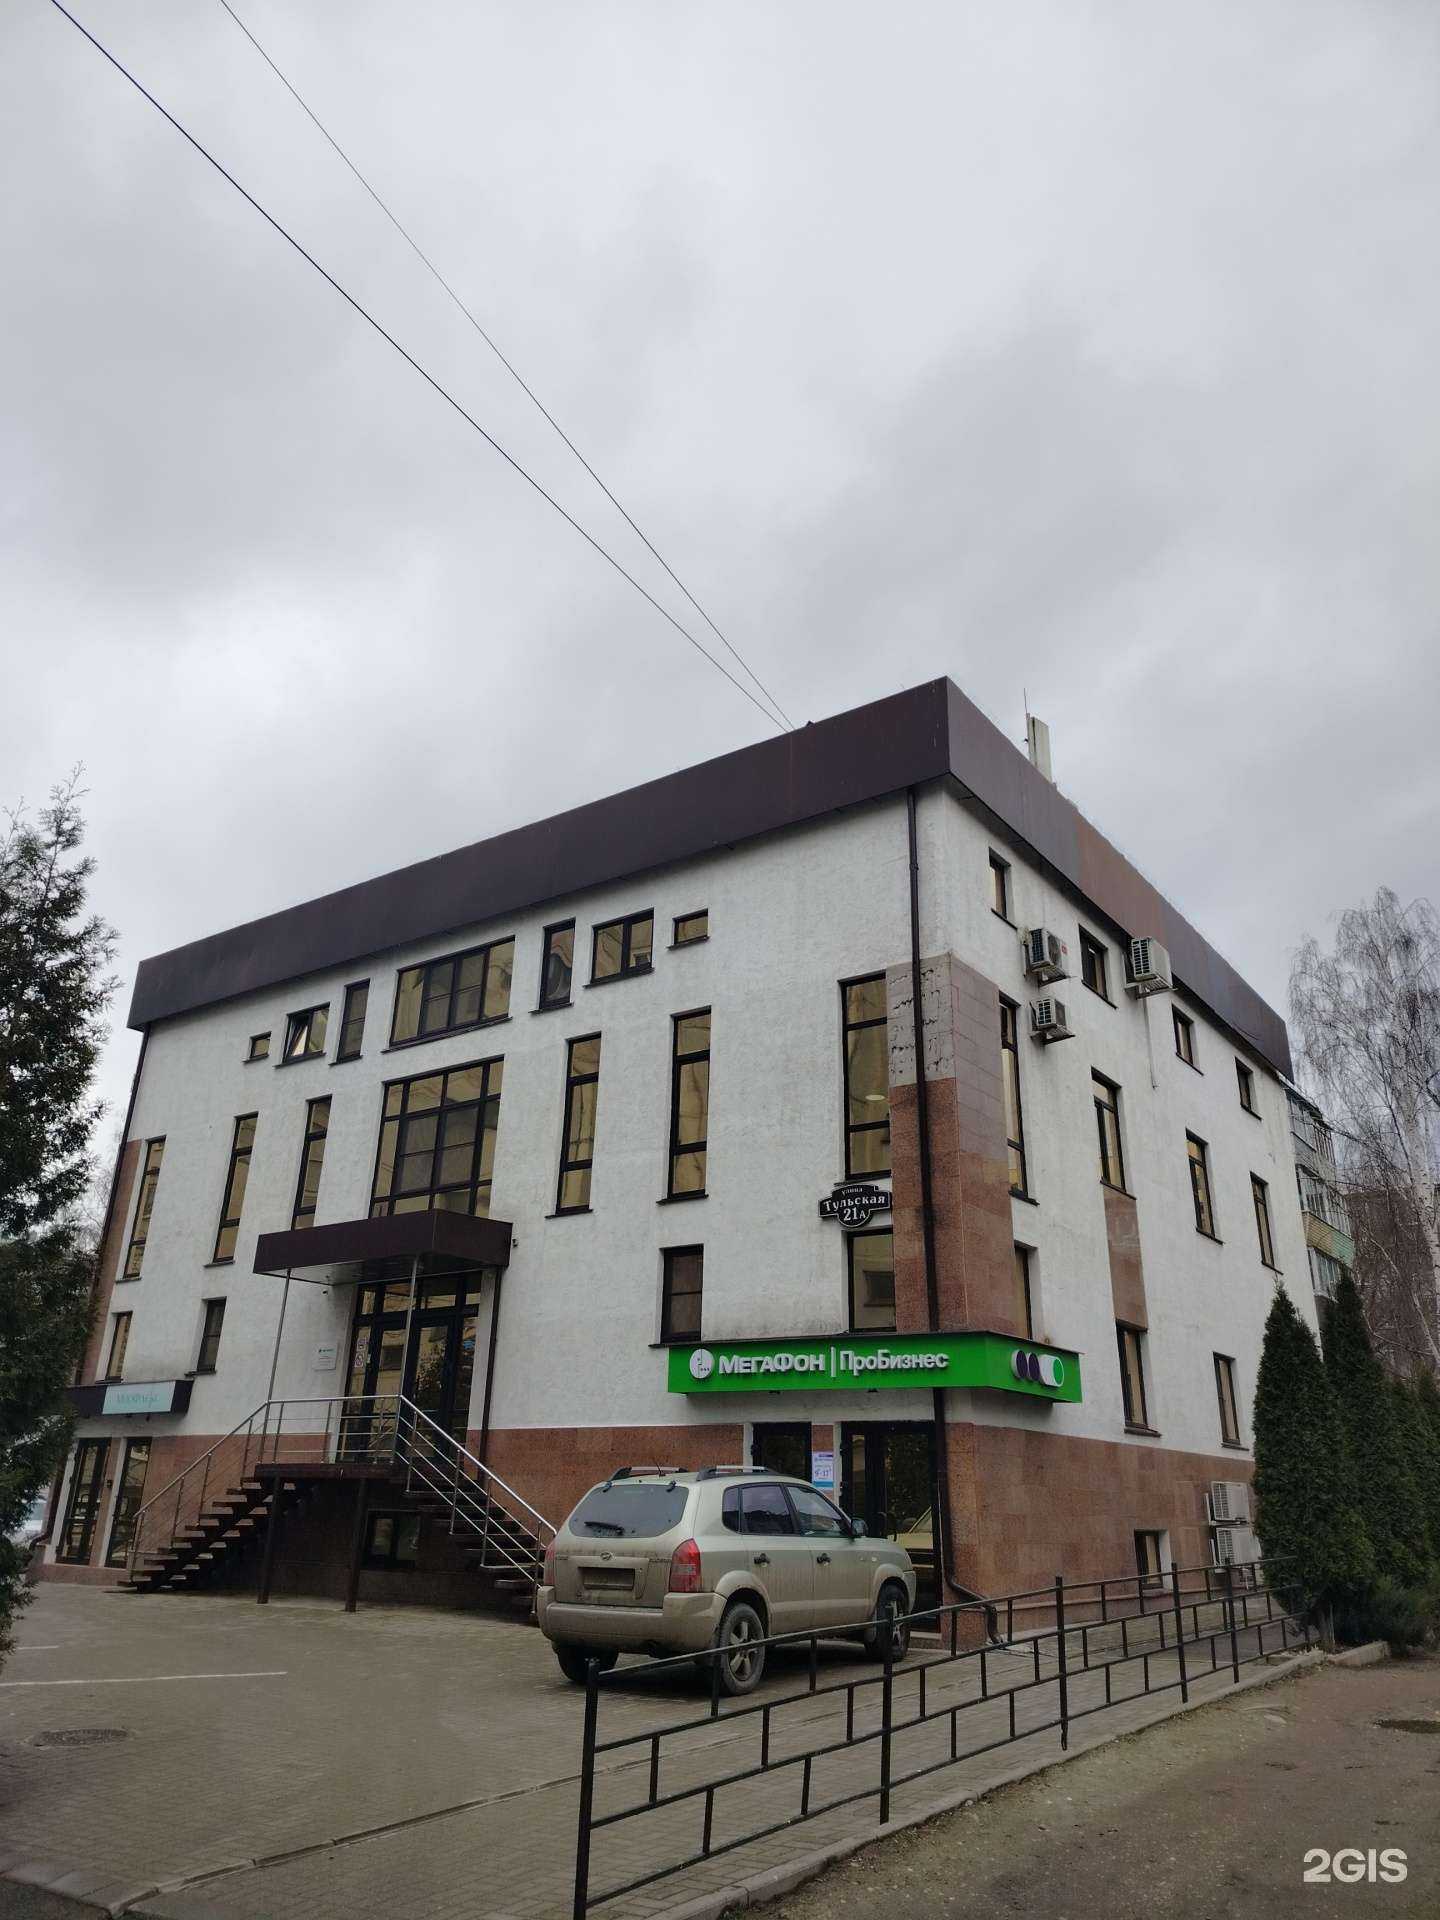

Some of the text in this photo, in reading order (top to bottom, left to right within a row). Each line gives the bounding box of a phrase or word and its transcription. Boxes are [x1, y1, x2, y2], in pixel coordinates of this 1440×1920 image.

[841, 1186, 863, 1196] улица
[823, 1195, 885, 1212] Тульская
[843, 1207, 866, 1221] 21А
[839, 1349, 949, 1376] ПроБизнес
